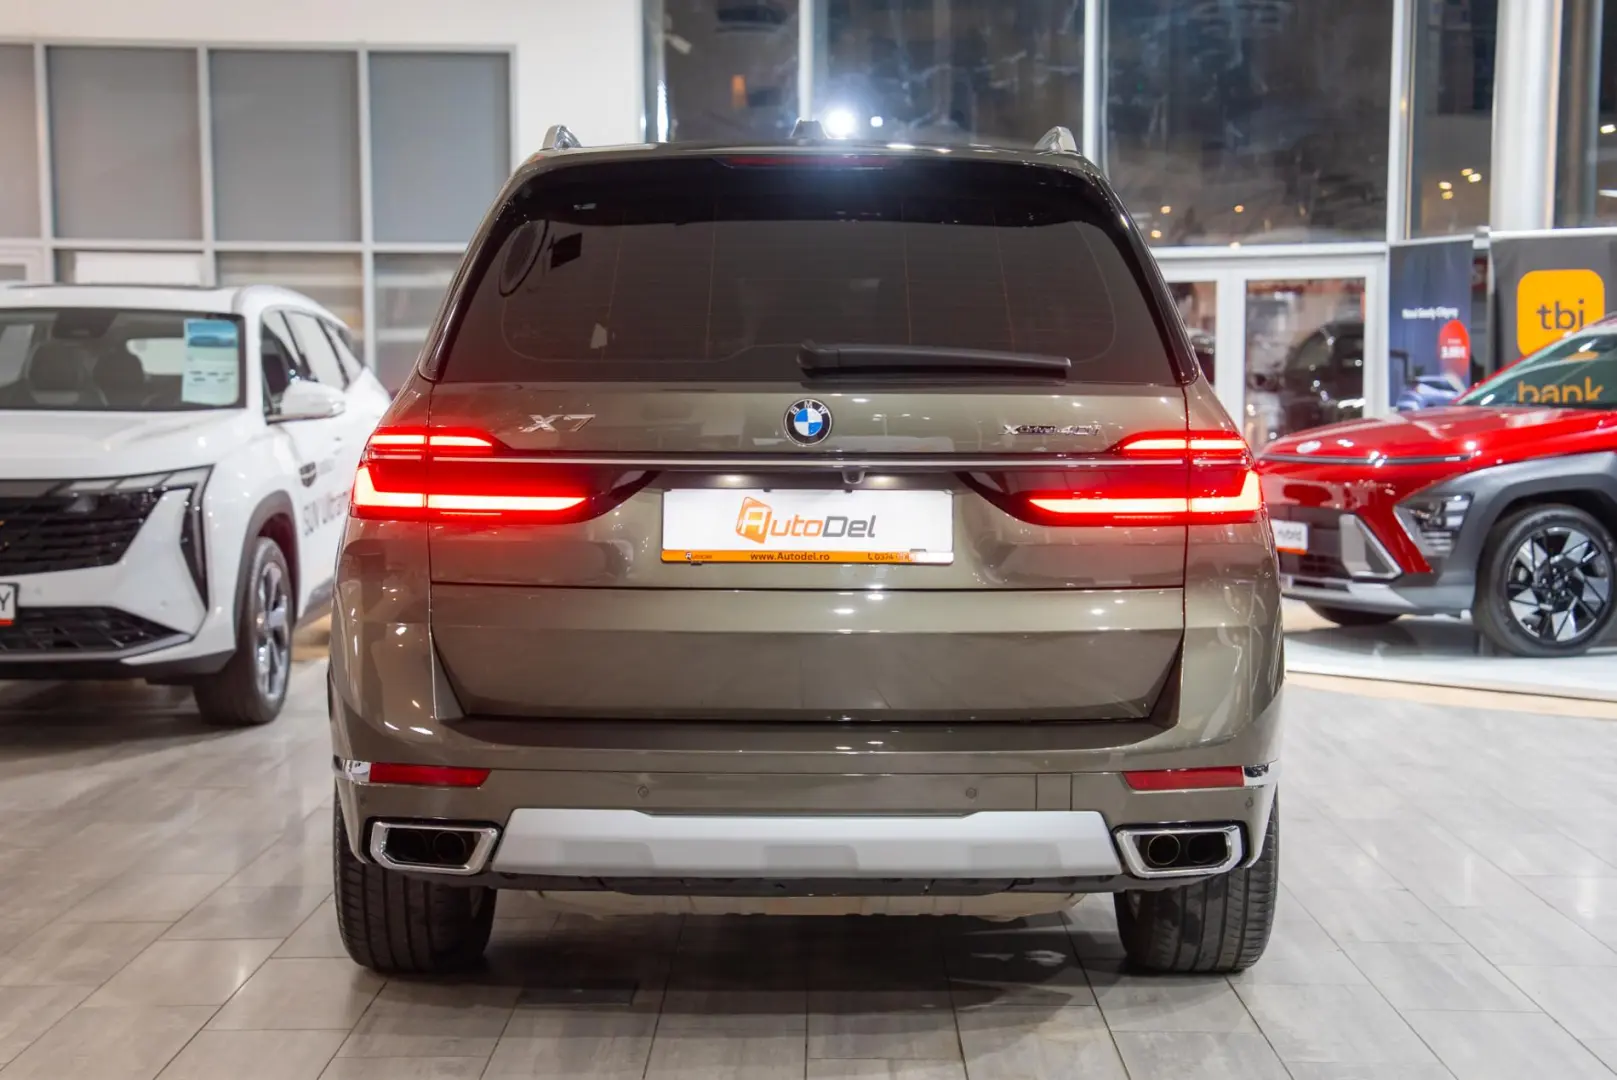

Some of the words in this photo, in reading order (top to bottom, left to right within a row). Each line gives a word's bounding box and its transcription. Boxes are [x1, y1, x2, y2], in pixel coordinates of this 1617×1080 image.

[1536, 299, 1585, 331] tbi
[1517, 376, 1604, 404] bank
[521, 414, 596, 433] X7
[750, 551, 830, 561] www.Autodel.ro
